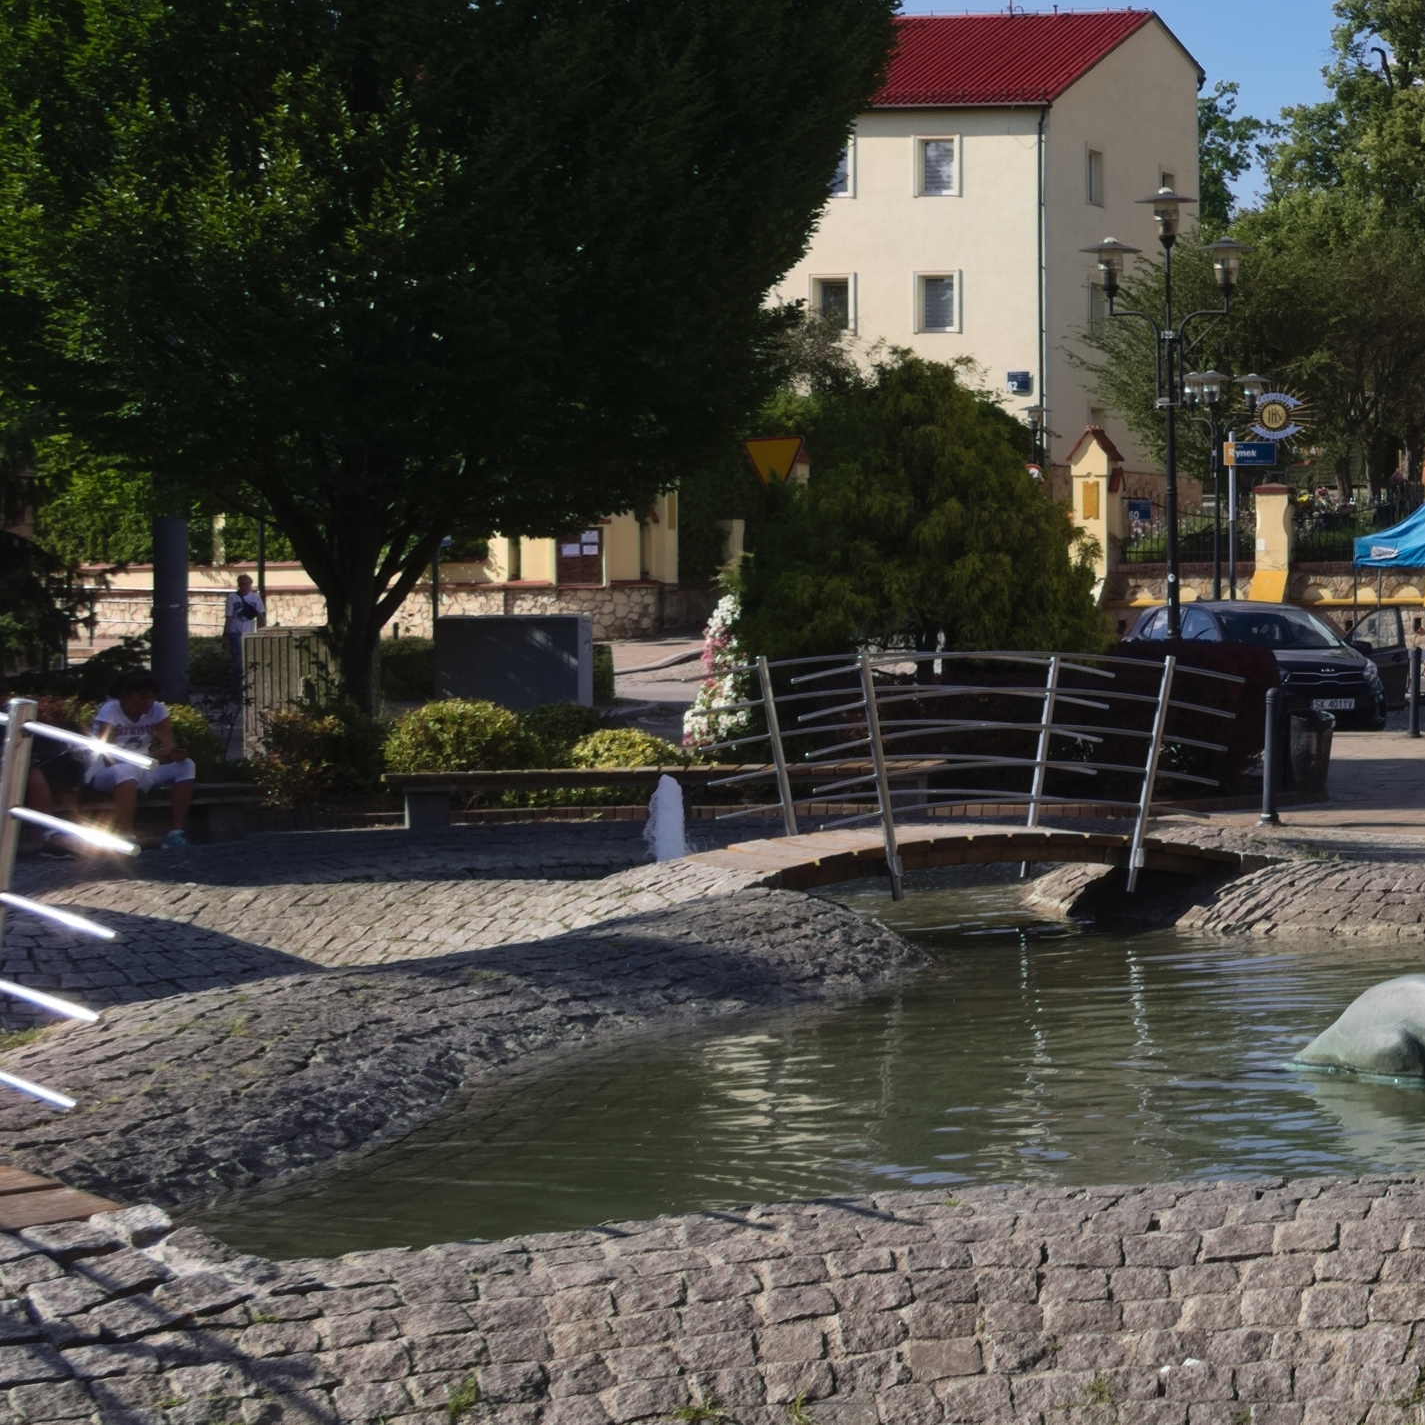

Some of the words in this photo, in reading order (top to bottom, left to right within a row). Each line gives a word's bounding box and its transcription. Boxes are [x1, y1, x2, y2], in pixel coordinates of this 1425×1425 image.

[1268, 408, 1283, 424] IHS
[1228, 449, 1257, 459] Rynek
[1128, 510, 1140, 520] 60
[1314, 699, 1325, 709] SK
